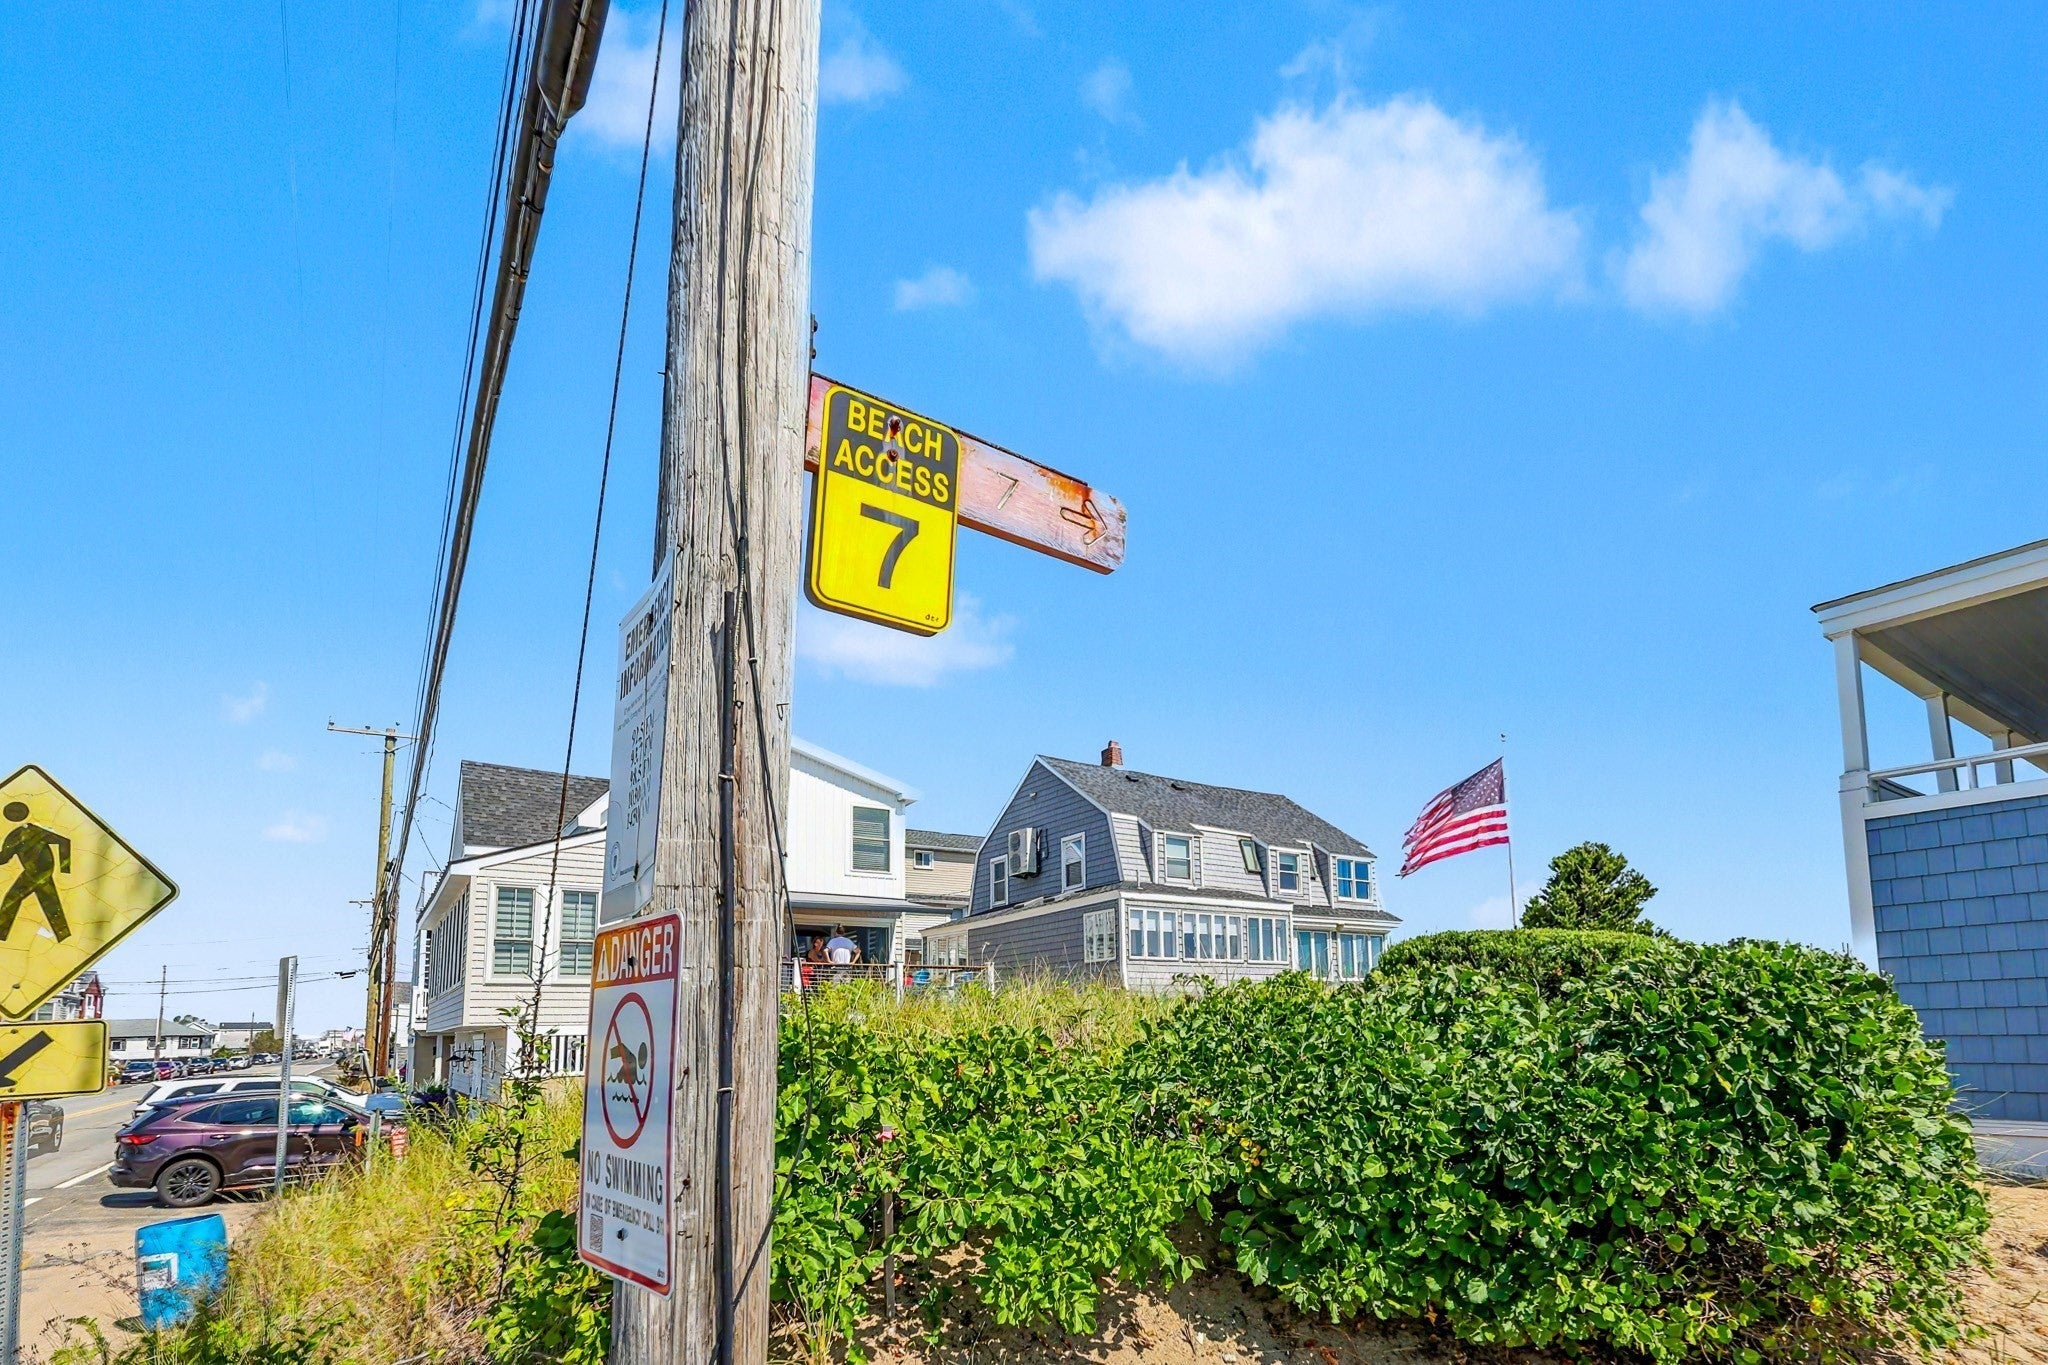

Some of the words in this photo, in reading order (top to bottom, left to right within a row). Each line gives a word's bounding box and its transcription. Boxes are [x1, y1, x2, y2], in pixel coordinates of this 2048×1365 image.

[847, 399, 942, 461] BEACH
[833, 438, 949, 504] ACCESS
[997, 471, 1019, 511] 7
[860, 502, 920, 589] 7
[611, 924, 674, 981] DANGER
[586, 1149, 601, 1185] NO
[605, 1153, 663, 1206] SWIMMING
